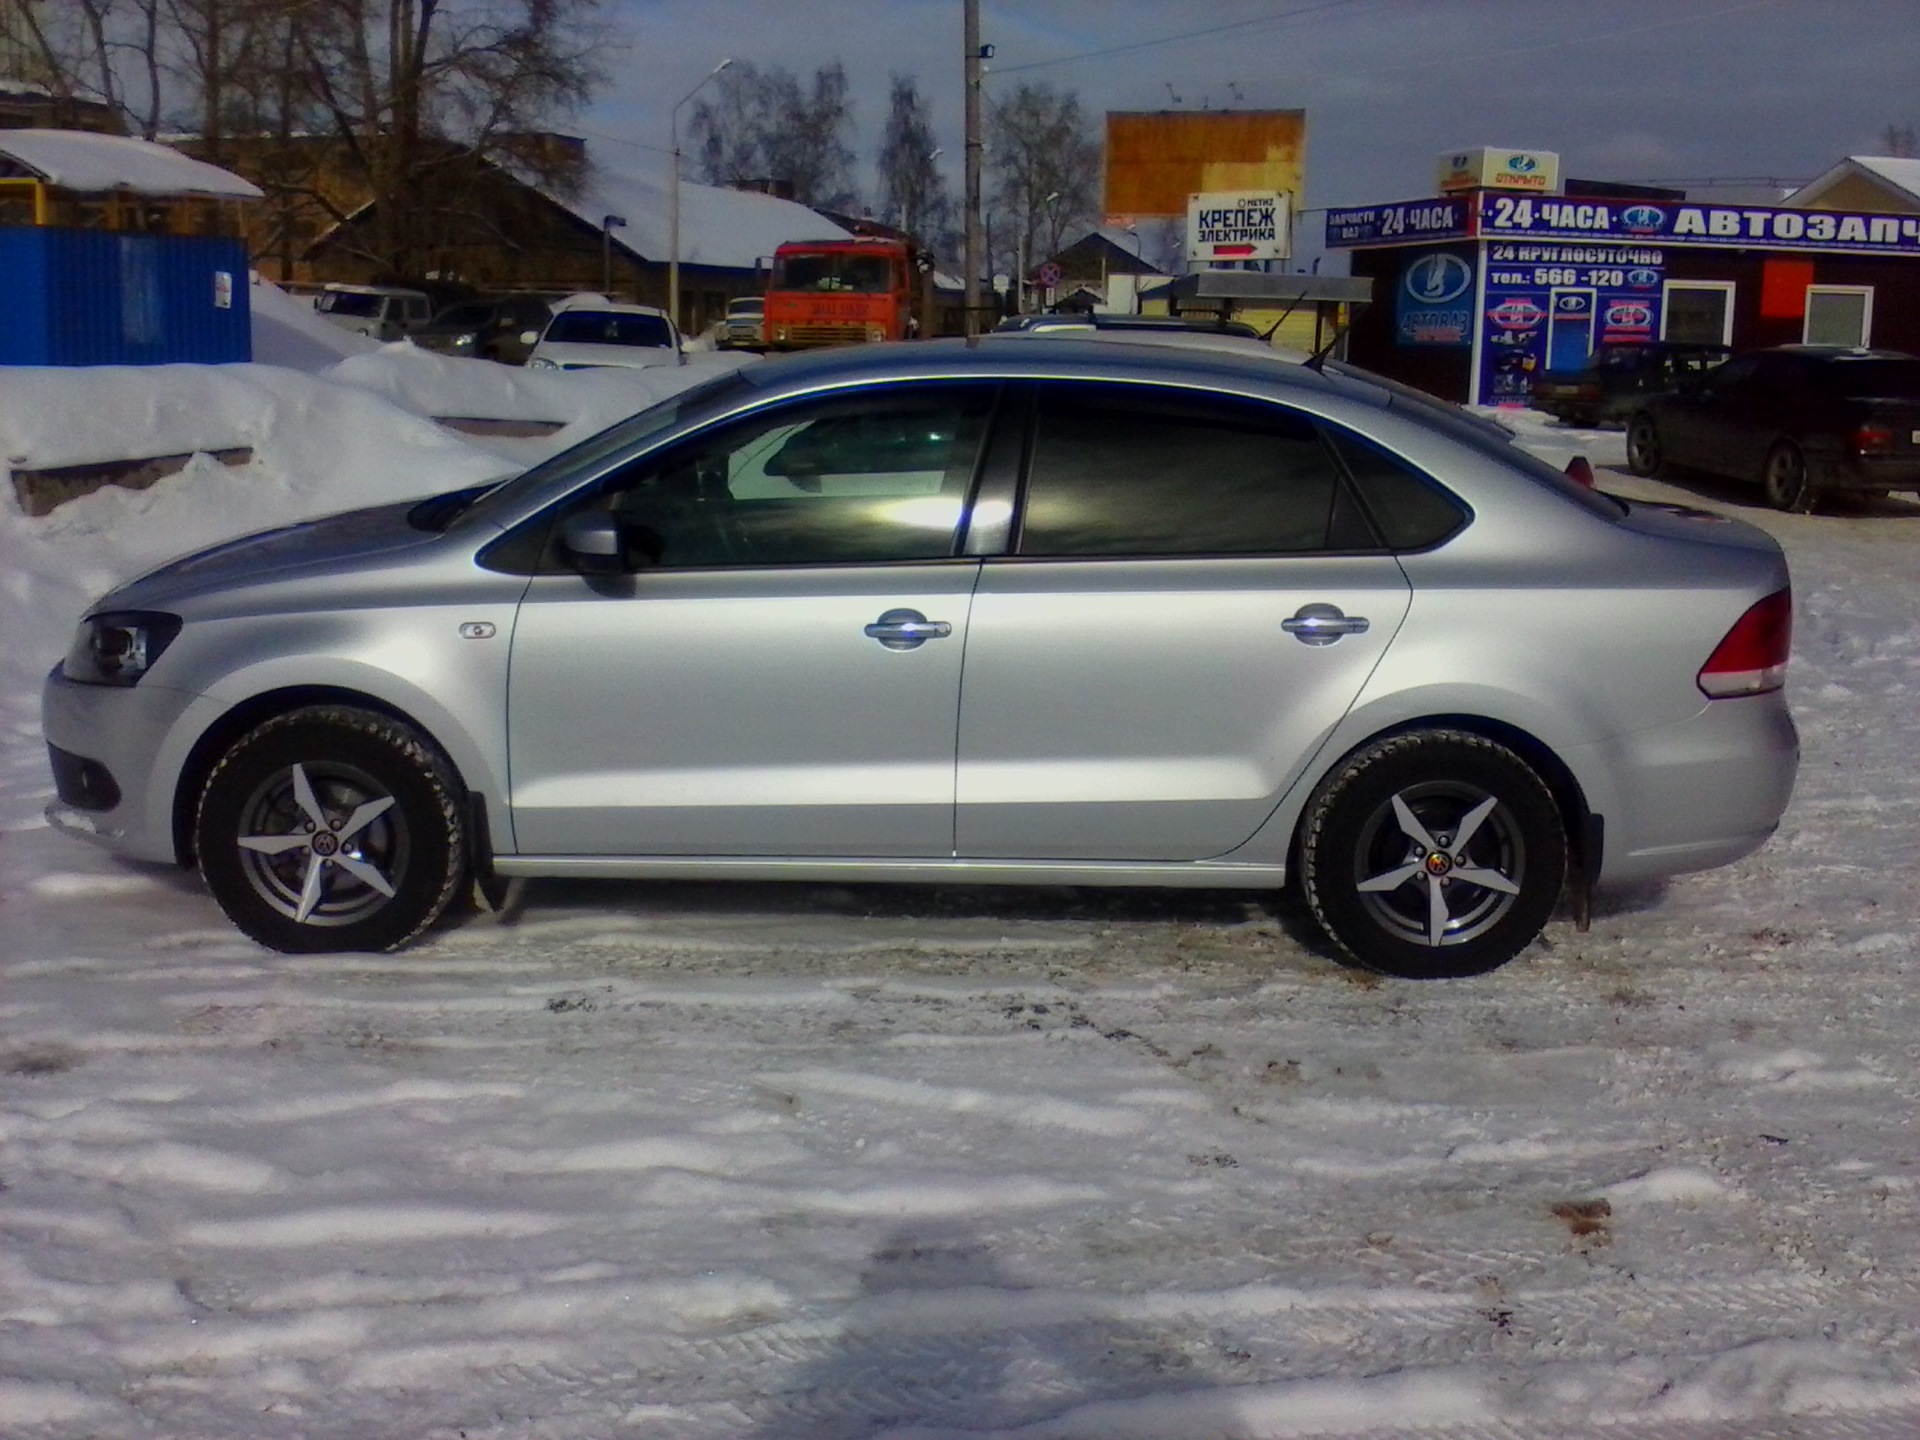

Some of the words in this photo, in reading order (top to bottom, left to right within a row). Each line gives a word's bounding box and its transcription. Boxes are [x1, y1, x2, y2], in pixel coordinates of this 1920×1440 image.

[1198, 207, 1276, 230] КРЕПЕЖ
[1381, 207, 1405, 236] 24
[1410, 205, 1453, 231] ЧАСА
[1493, 197, 1534, 229] 24
[1541, 203, 1610, 230] ЧАСА
[1197, 228, 1276, 243] ЭЛЕКТРИКА
[1492, 244, 1515, 261] 24
[1518, 246, 1663, 266] КРУГЛОСУТОЧНО
[1534, 267, 1577, 286] 566
